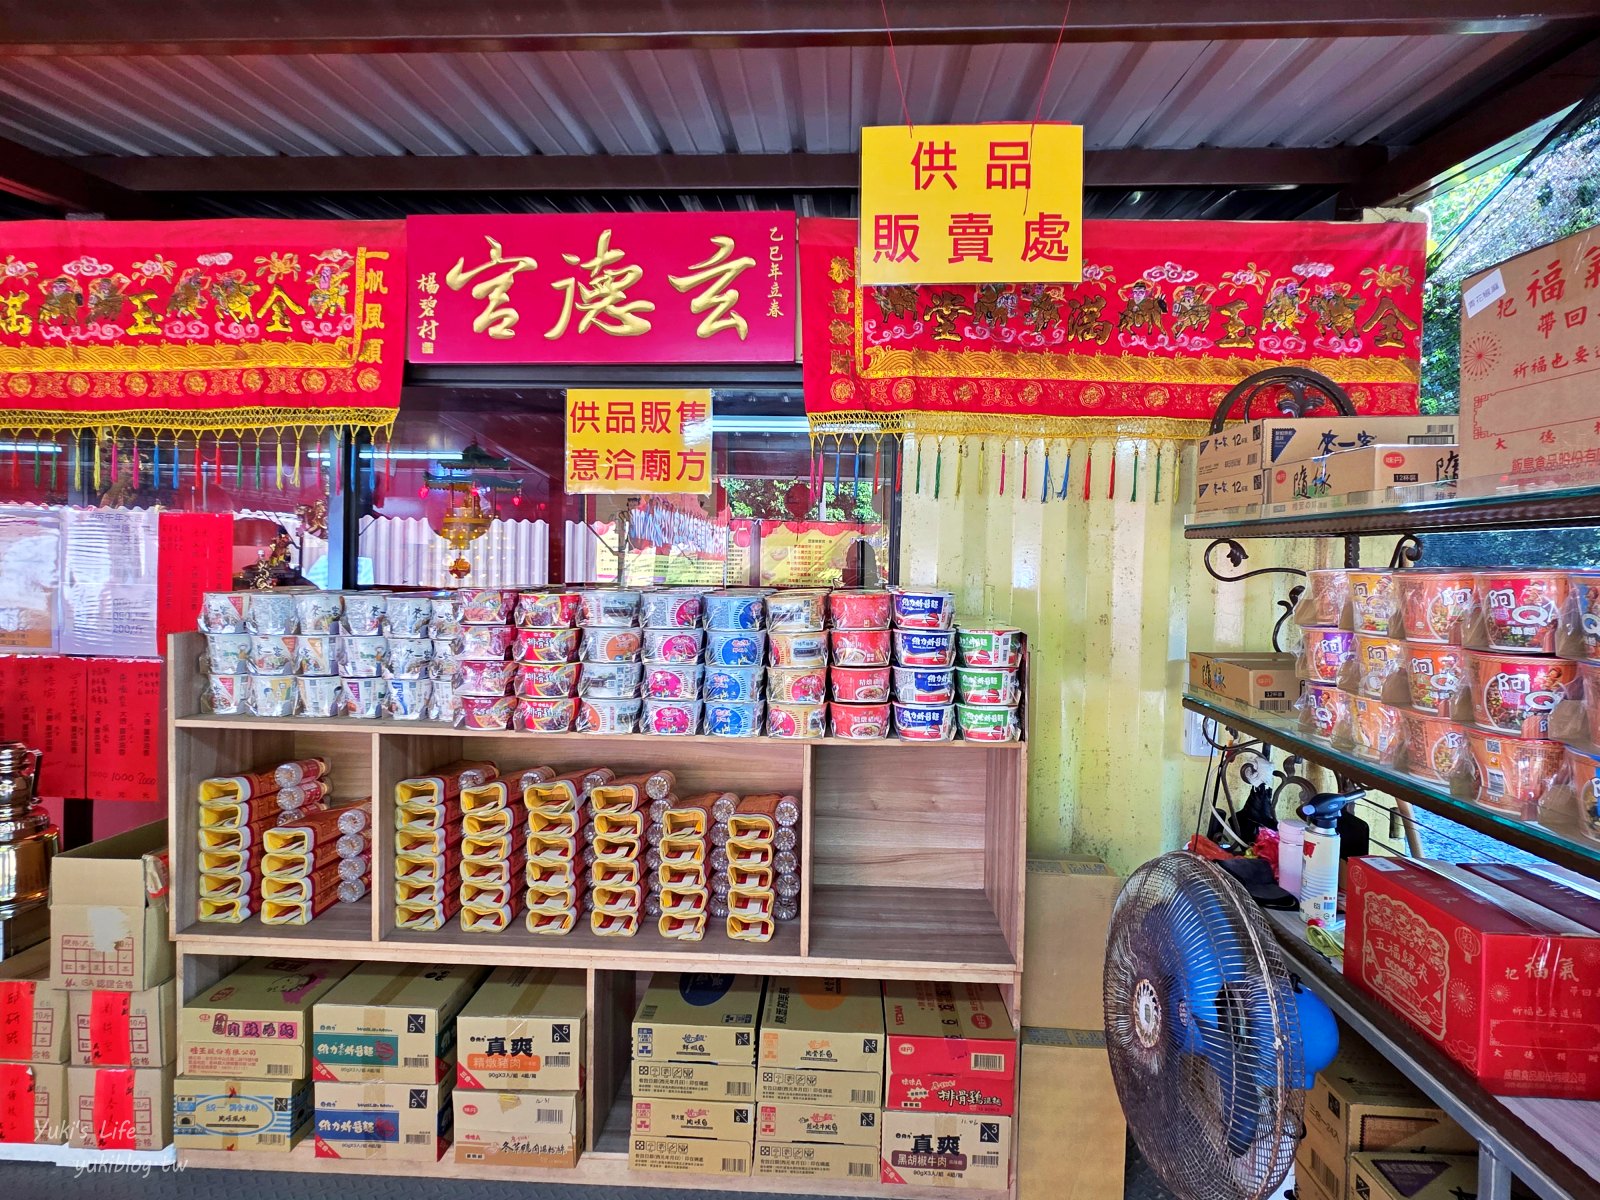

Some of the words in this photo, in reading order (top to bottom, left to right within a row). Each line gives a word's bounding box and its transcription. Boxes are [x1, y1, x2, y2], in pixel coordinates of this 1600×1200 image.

[910, 140, 1032, 190] 供品
[873, 212, 1070, 264] 販賣處
[765, 227, 784, 318] 乙巳年立春
[570, 401, 707, 435] 供品販售
[570, 448, 707, 482] 意洽廟方
[417, 1015, 424, 1024] 4
[409, 1023, 416, 1032] 5
[562, 1025, 568, 1034] 5
[553, 1033, 559, 1041] 6
[485, 1037, 533, 1057] 真爽
[419, 1091, 426, 1099] 4
[411, 1099, 417, 1107] 5
[991, 1124, 998, 1133] 3
[981, 1132, 988, 1141] 4
[911, 1134, 961, 1155] 真爽
[897, 1154, 947, 1167] 黑胡椒牛肉
